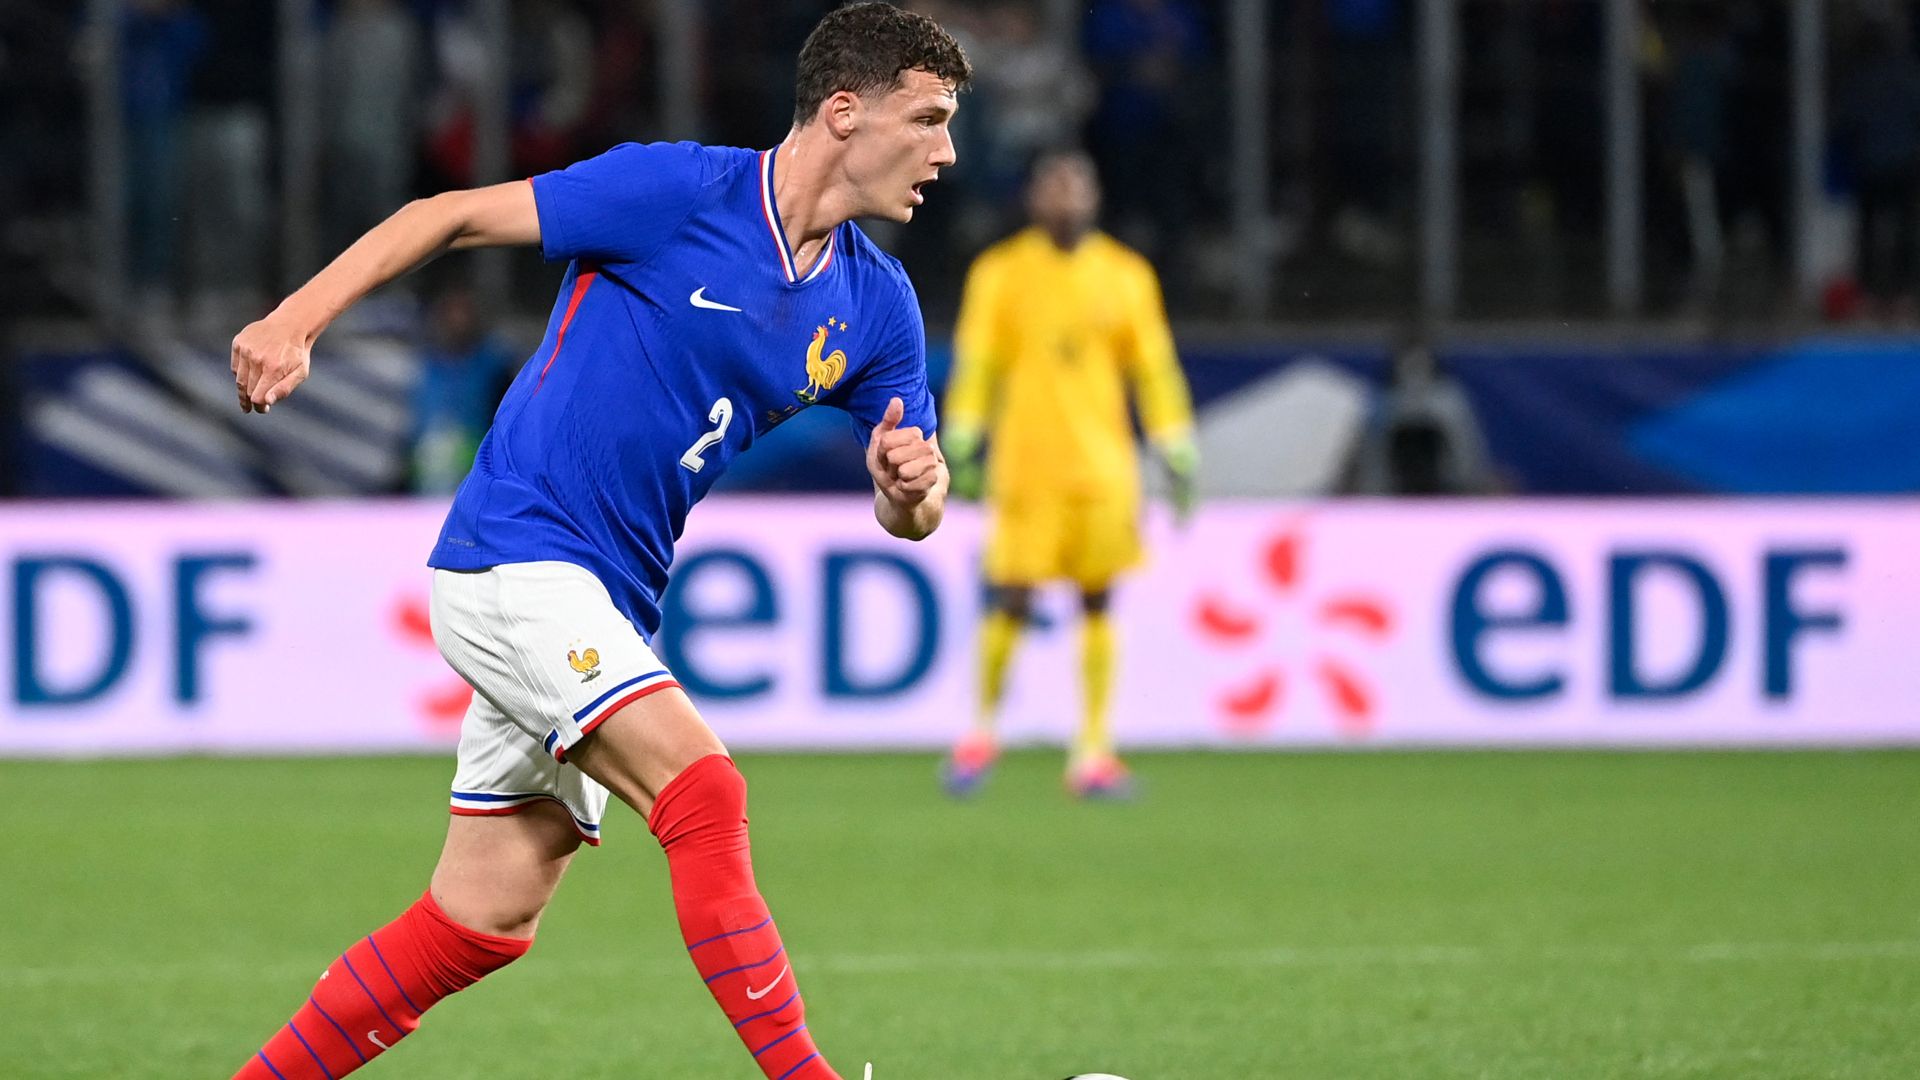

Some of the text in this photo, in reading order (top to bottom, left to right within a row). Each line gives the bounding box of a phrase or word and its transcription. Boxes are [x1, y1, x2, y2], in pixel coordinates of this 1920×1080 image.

[679, 397, 733, 473] 2
[662, 548, 1053, 702] eD
[1449, 548, 1848, 702] eDF
